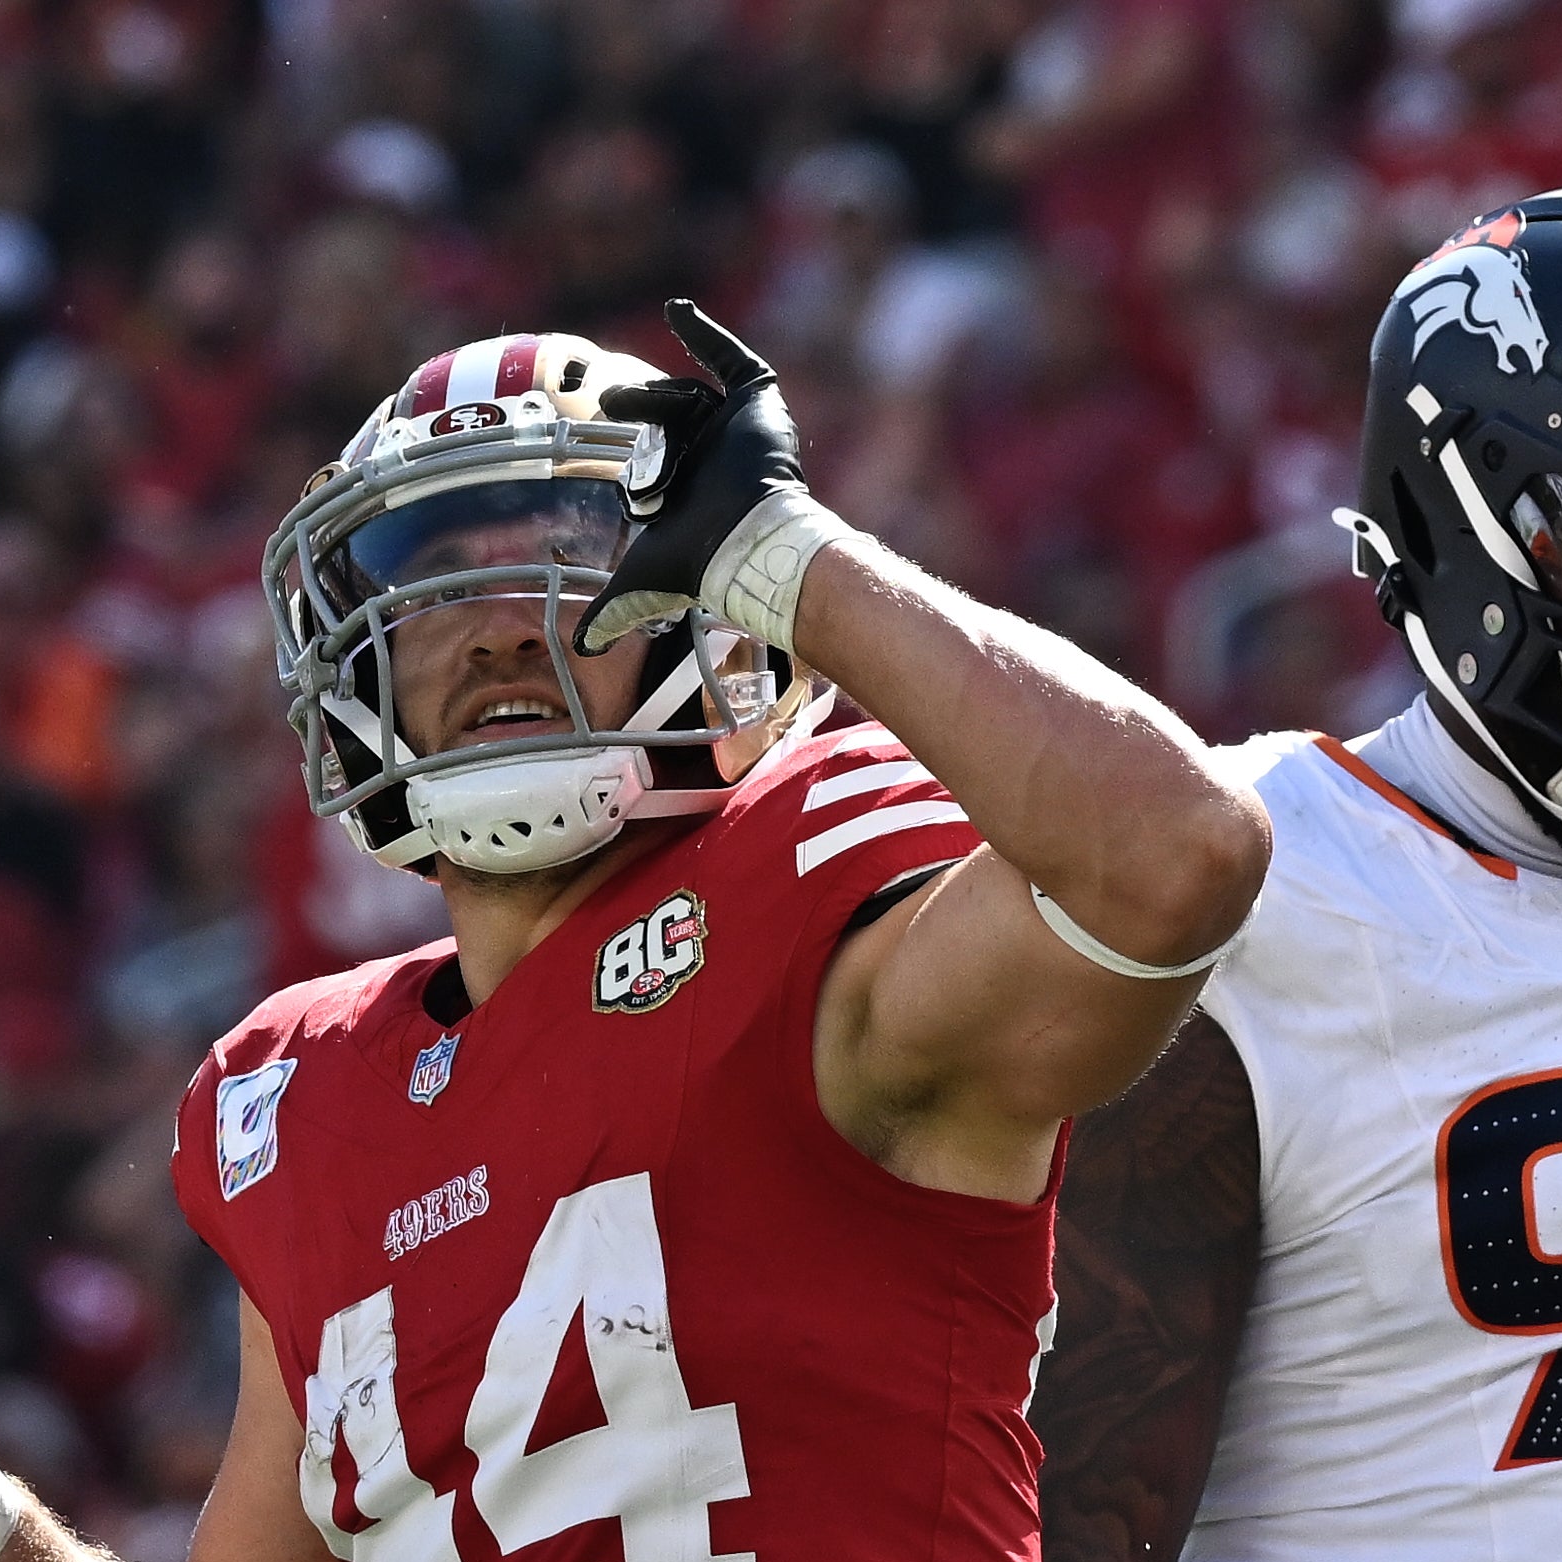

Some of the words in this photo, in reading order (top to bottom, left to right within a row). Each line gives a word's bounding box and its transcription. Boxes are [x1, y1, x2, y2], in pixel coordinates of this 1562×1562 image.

[223, 1066, 284, 1162] C
[416, 1060, 443, 1091] NFL
[383, 1164, 490, 1261] 49ERS
